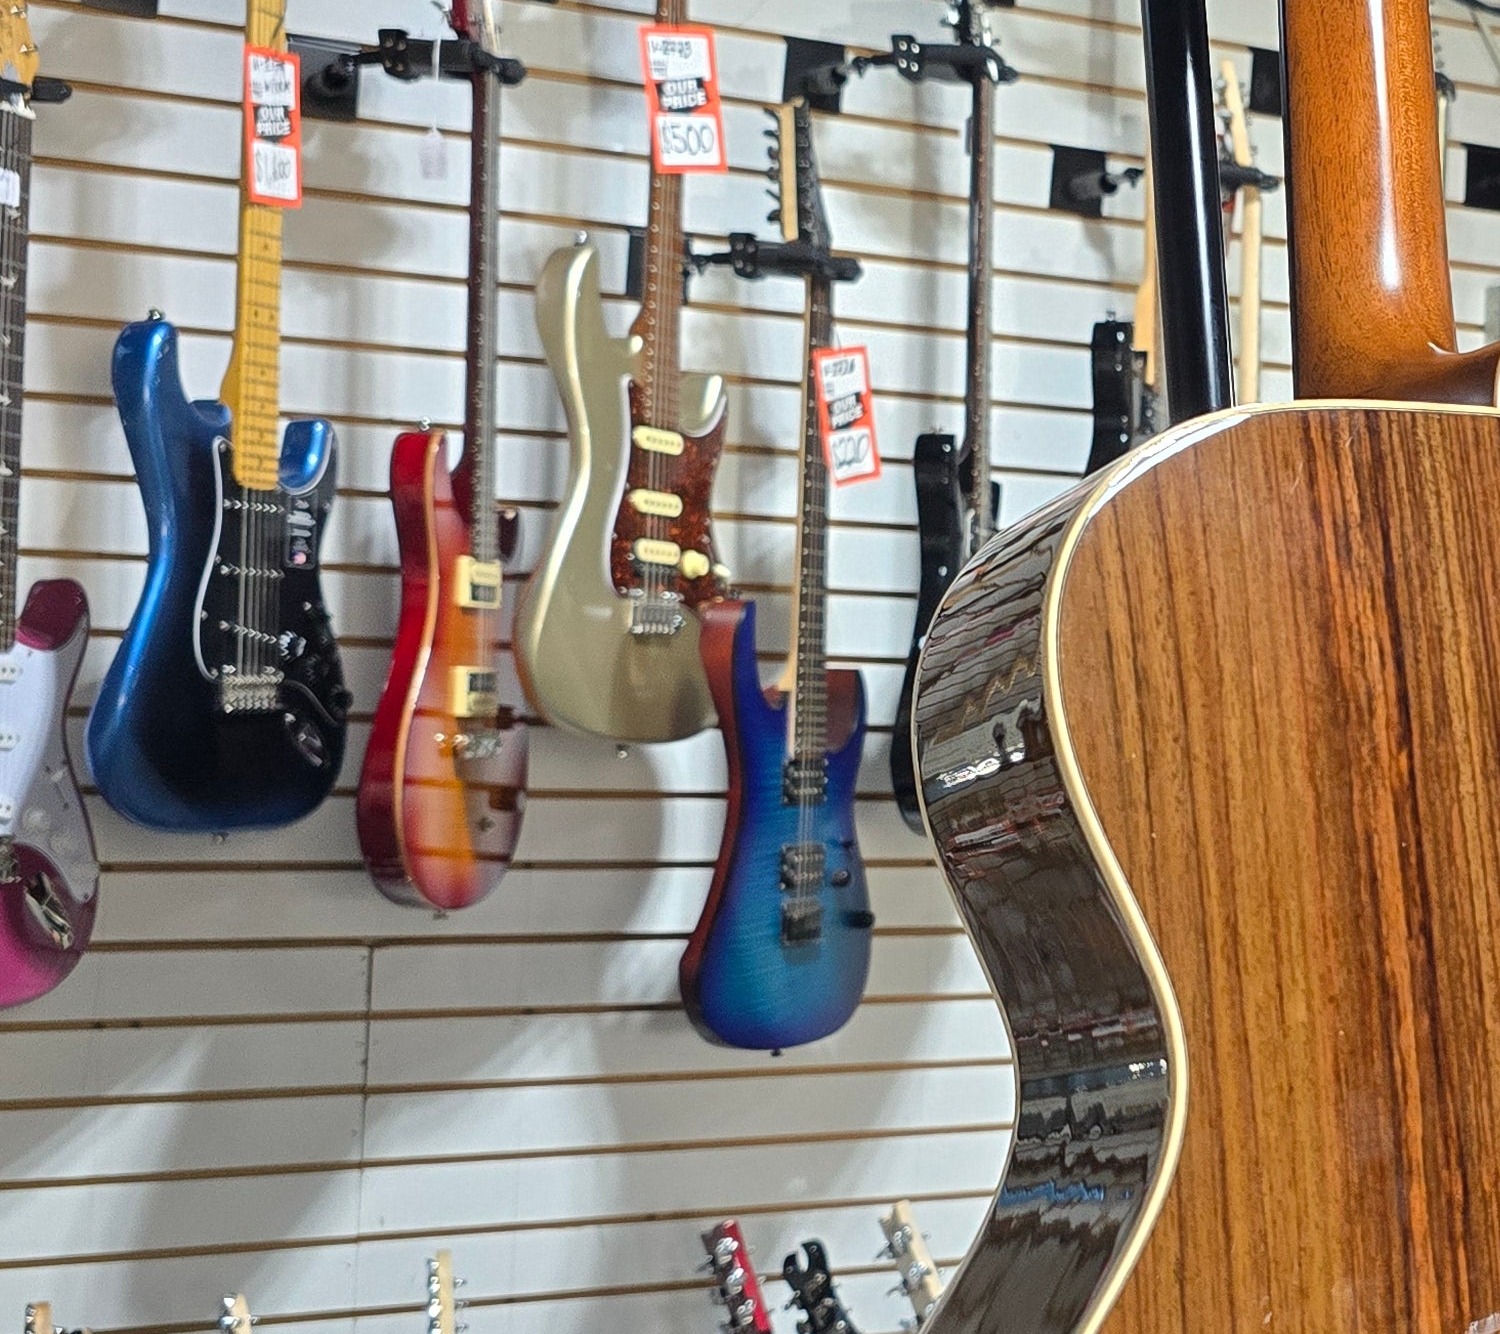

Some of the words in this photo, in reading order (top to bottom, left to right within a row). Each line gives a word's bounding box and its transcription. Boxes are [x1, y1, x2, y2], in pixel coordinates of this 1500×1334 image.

[662, 79, 697, 96] OUR
[662, 92, 707, 110] PRICE
[257, 105, 286, 121] OUR
[256, 119, 291, 137] PRICE
[661, 121, 714, 156] $500
[830, 394, 857, 415] OUR
[831, 406, 864, 429] PRICE
